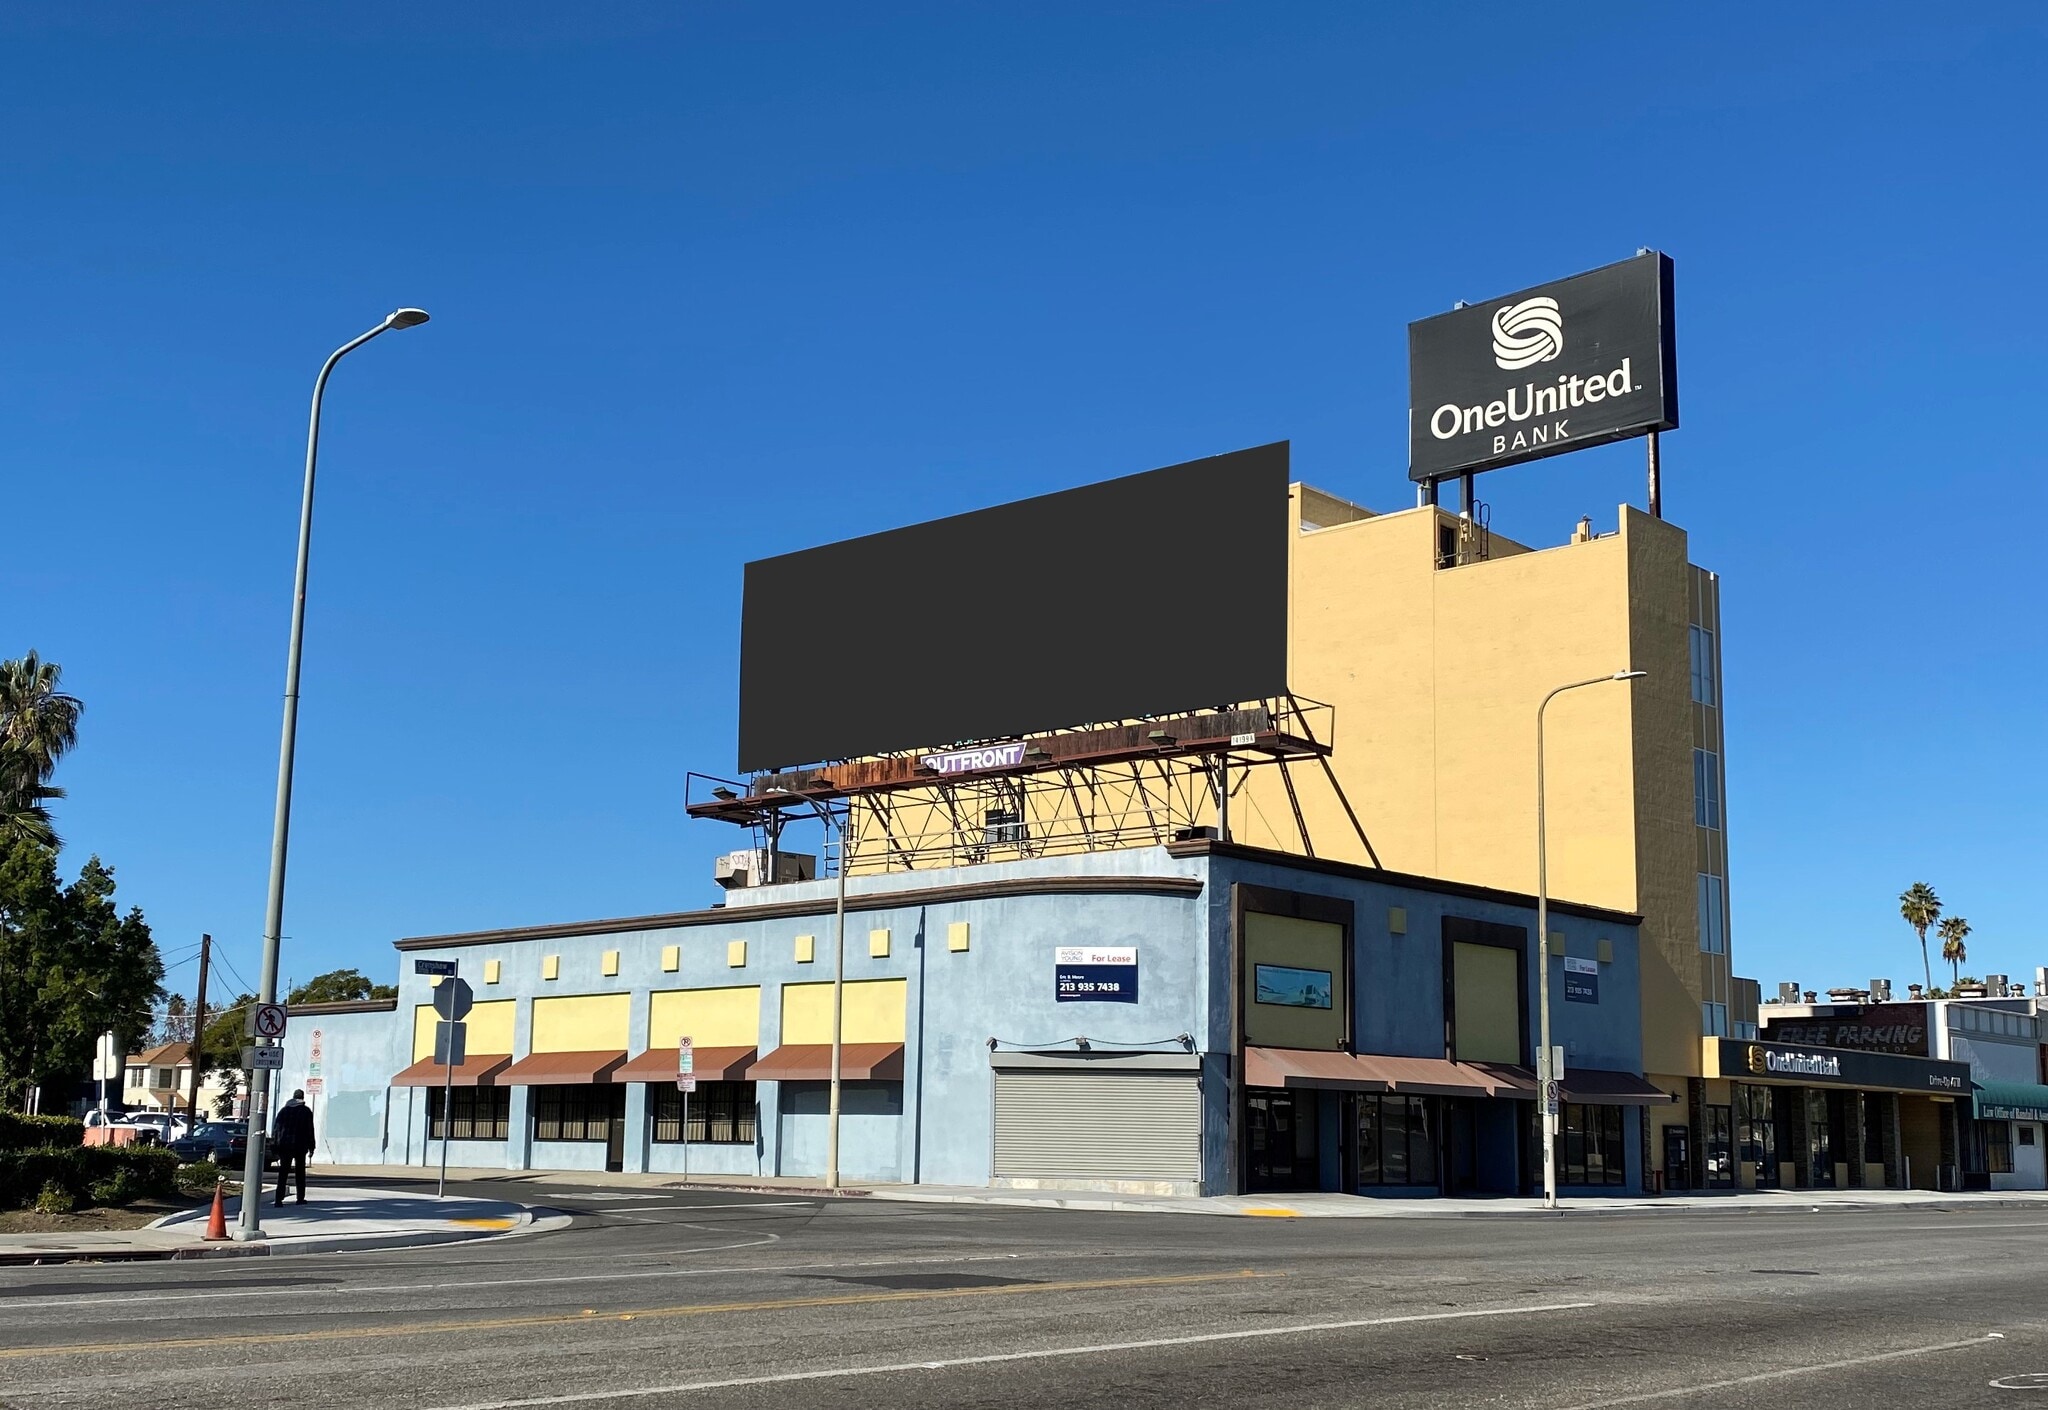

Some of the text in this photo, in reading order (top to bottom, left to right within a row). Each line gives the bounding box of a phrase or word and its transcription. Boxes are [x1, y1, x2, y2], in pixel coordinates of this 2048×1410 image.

[1430, 357, 1632, 440] OneUnited
[1492, 419, 1570, 455] BANK
[925, 747, 1020, 774] OUTFRONT
[1059, 982, 1120, 992] 213 935 7438
[1777, 1024, 1923, 1045] FREE PARKING
[1983, 1105, 1994, 1118] Law
